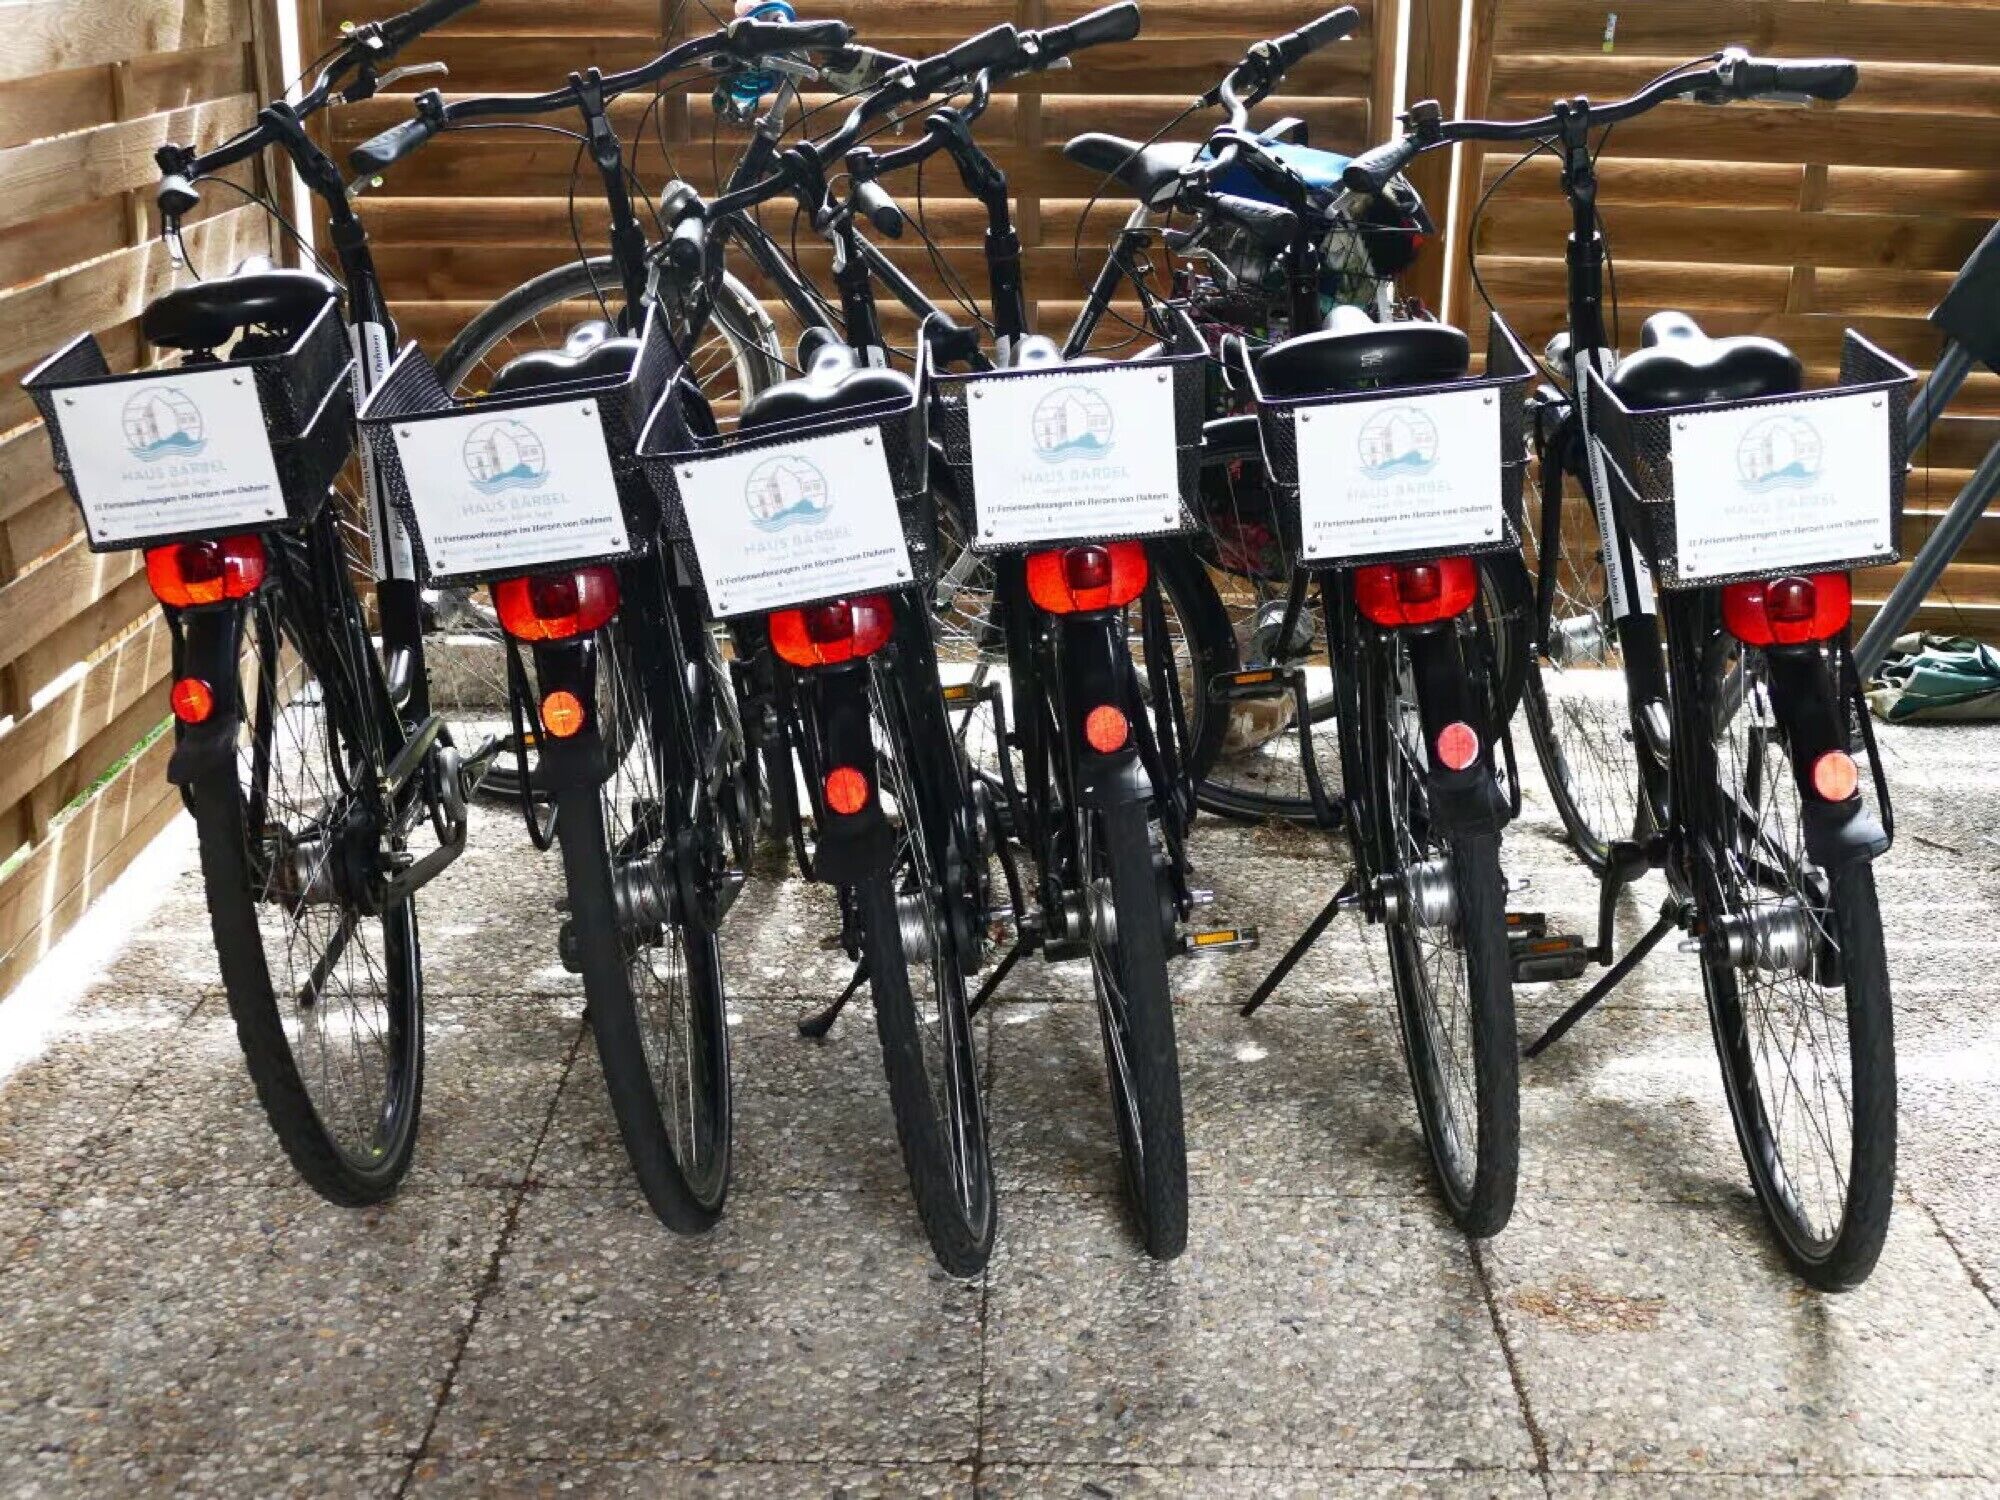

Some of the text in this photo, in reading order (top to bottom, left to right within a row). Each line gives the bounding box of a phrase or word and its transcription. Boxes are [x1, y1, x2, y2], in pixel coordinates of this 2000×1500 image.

[191, 490, 221, 500] Herzen
[222, 488, 237, 496] von
[1412, 510, 1441, 519] Herzen
[1442, 507, 1458, 515] von
[532, 523, 562, 532] Herzen
[562, 520, 579, 528] von
[814, 557, 844, 568] Herzen
[845, 554, 861, 562] von
